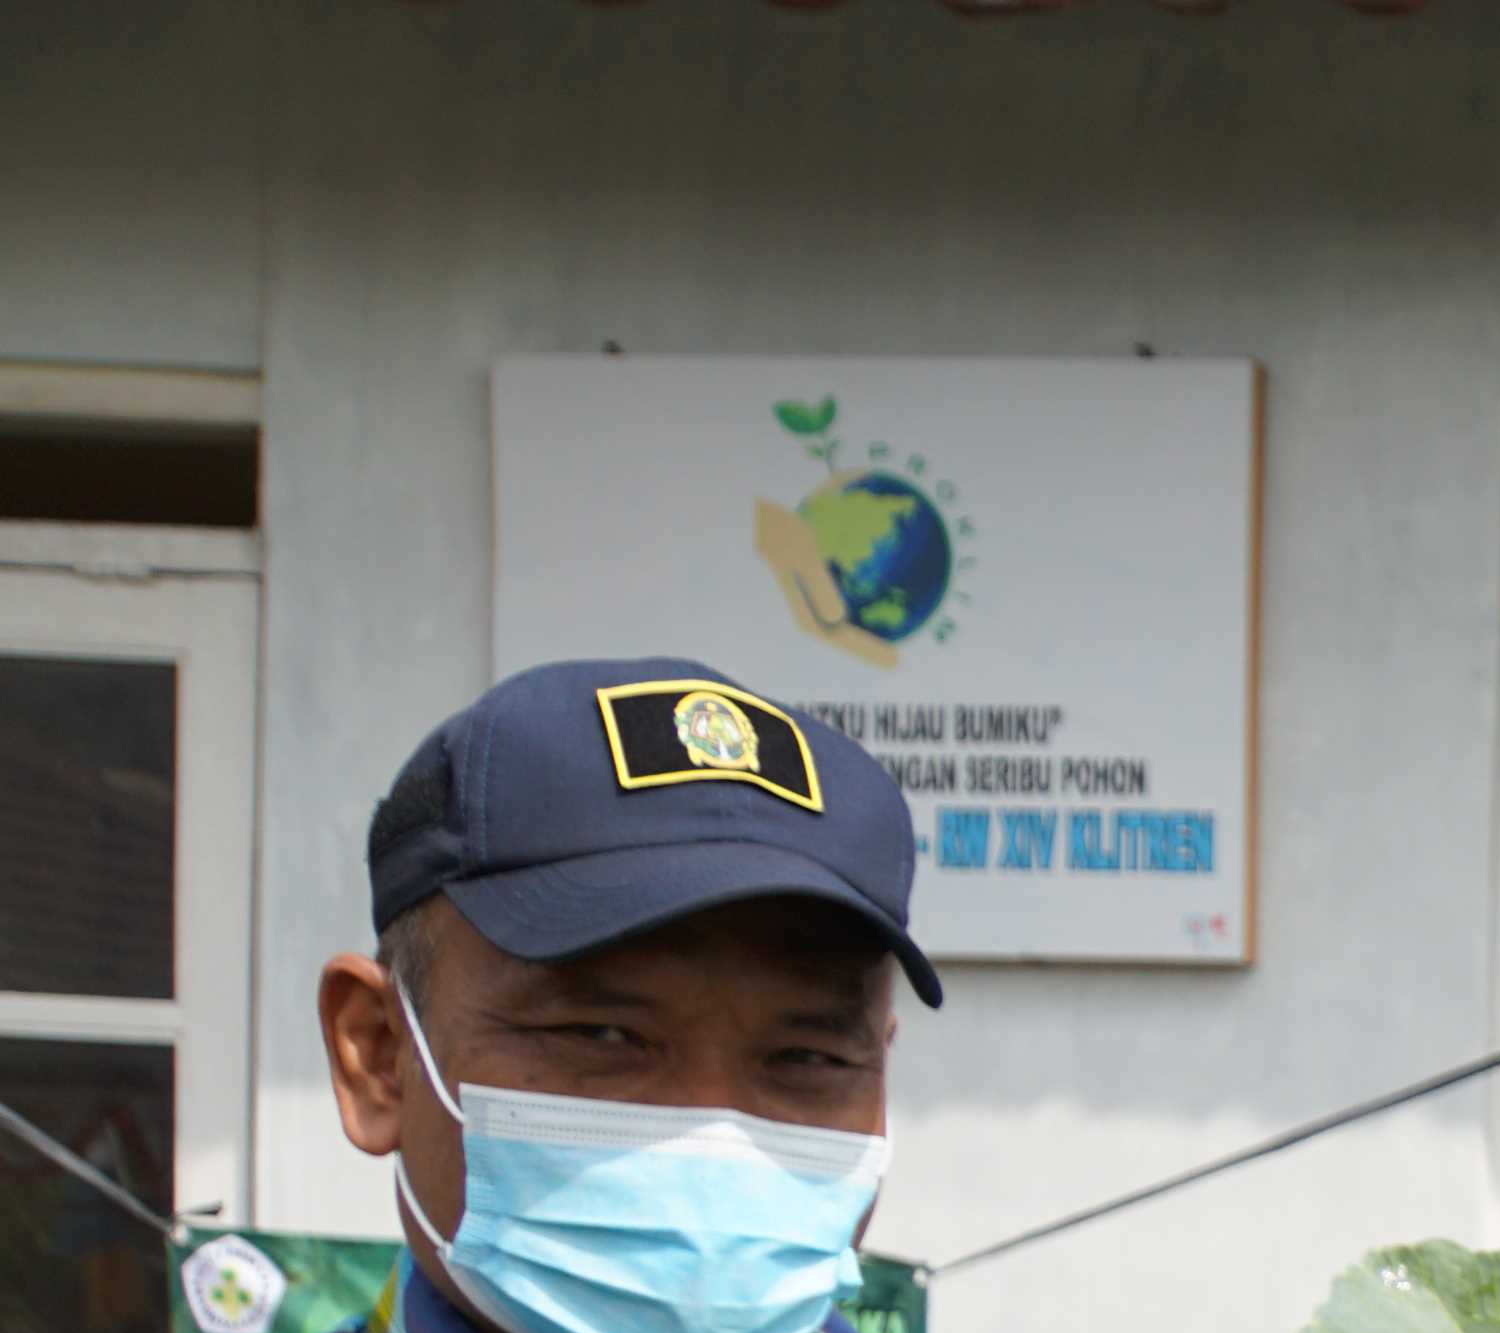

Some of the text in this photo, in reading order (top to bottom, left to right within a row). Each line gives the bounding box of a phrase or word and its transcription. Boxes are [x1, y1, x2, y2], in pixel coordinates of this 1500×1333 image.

[873, 702, 944, 741] HIJAU
[965, 755, 1050, 793] SERIBU
[1061, 756, 1147, 795] POHON
[999, 810, 1058, 868] XIV
